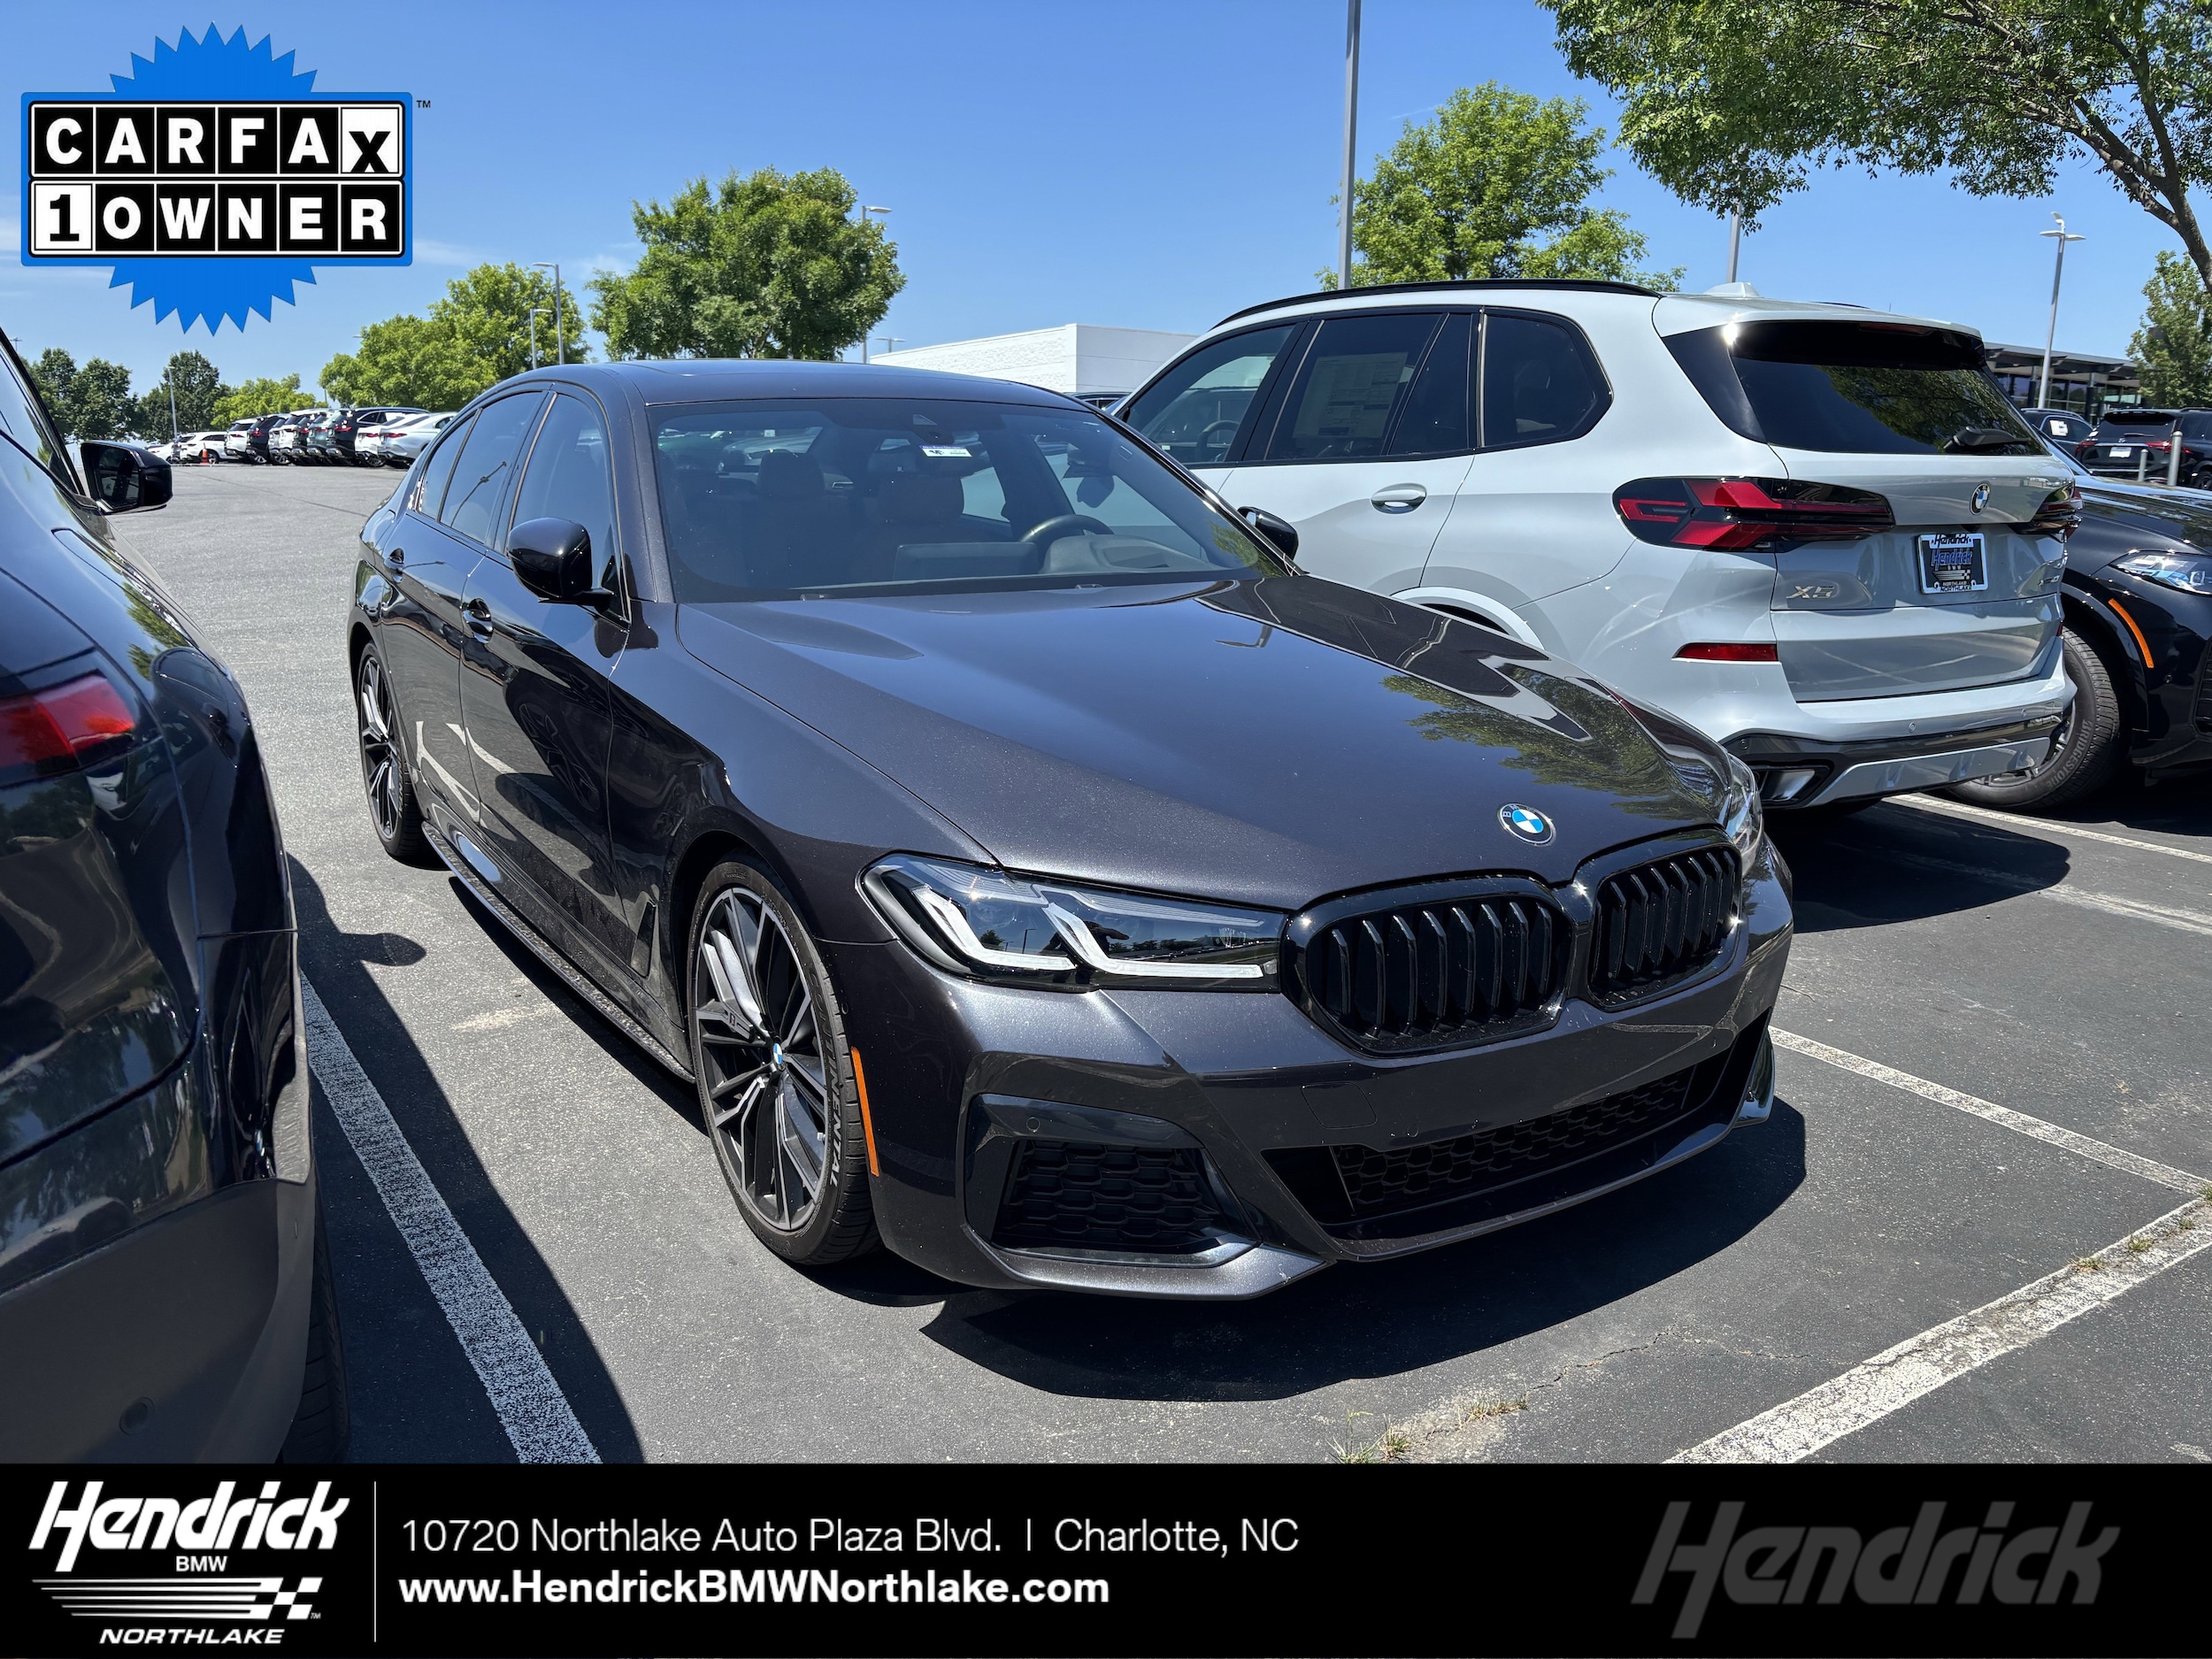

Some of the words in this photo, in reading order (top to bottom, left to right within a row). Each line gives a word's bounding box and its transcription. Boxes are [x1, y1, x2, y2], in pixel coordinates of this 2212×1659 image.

[1931, 548, 1973, 572] Hendrick
[1786, 586, 1835, 599] X5
[808, 970, 843, 1188] CONTINENTAL
